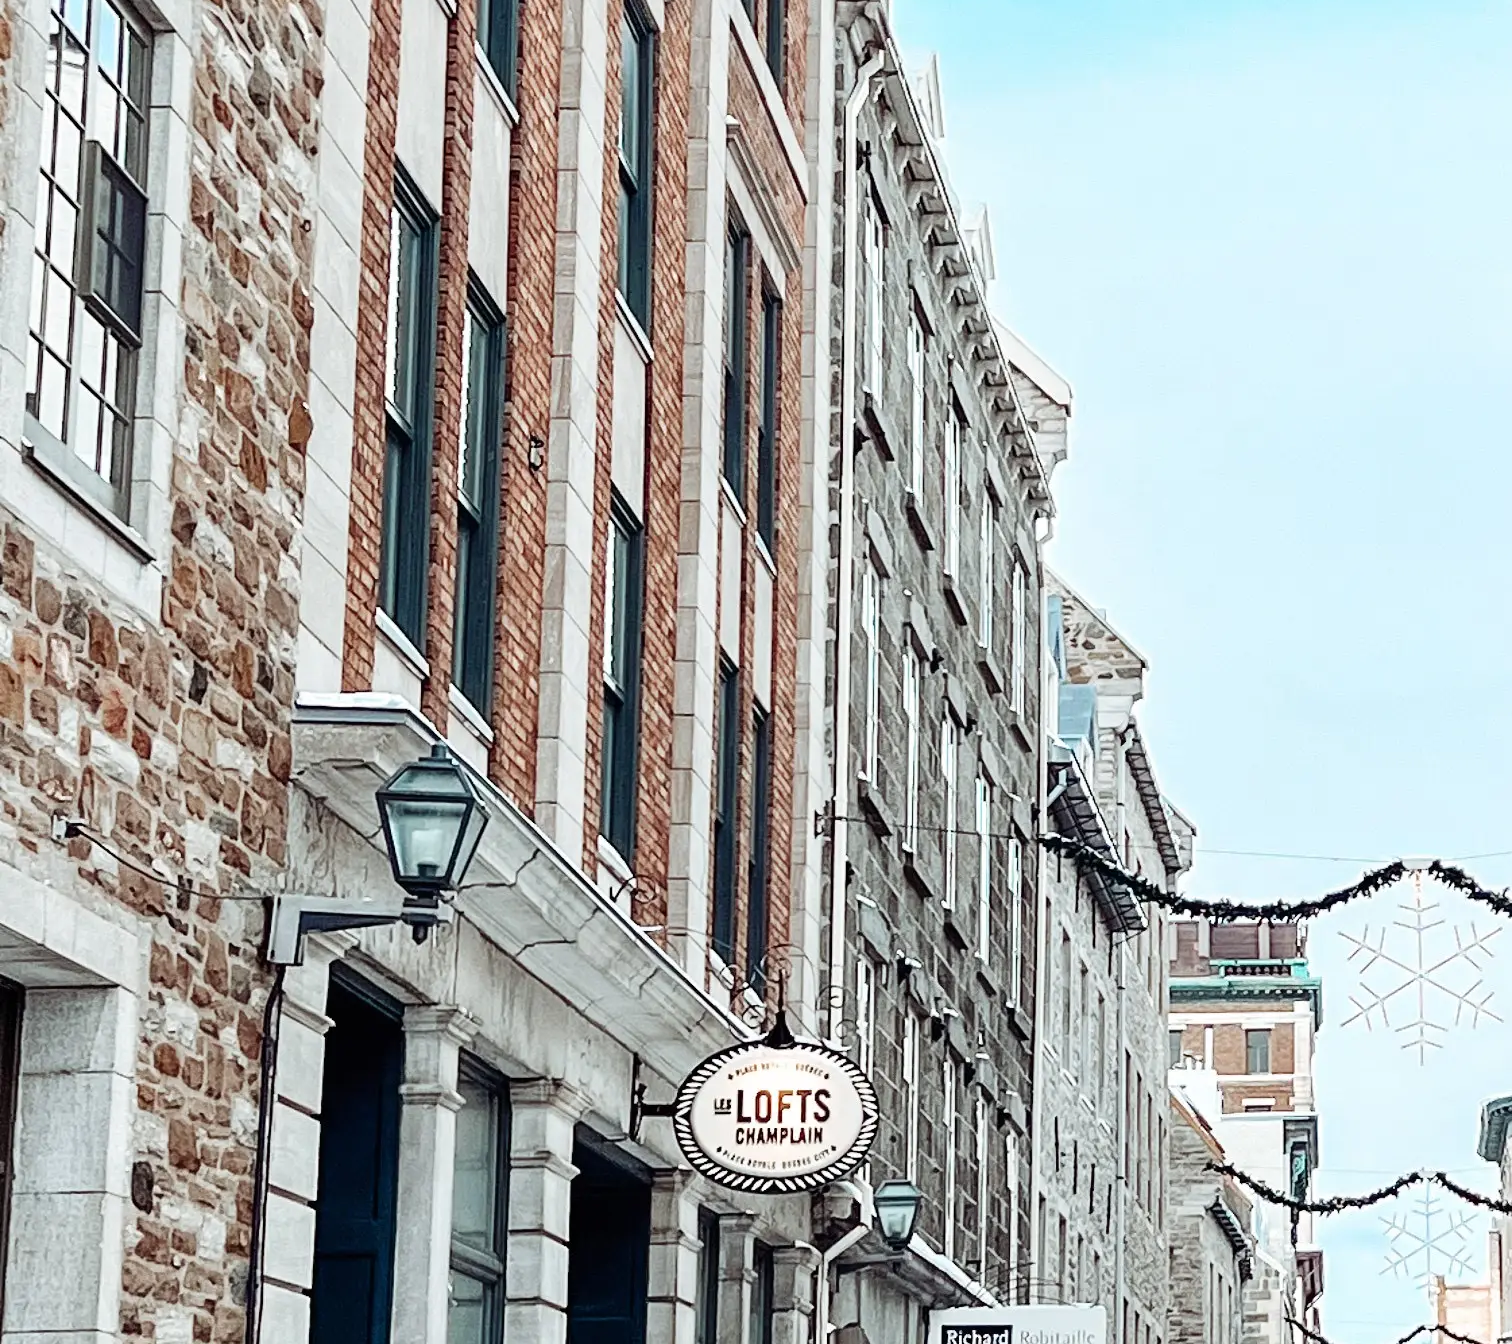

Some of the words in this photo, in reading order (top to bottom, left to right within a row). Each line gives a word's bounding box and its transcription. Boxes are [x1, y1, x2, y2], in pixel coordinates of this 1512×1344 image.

[714, 1098, 732, 1111] LES
[736, 1089, 831, 1124] LOFTS
[735, 1127, 823, 1145] CHAMPLAIN
